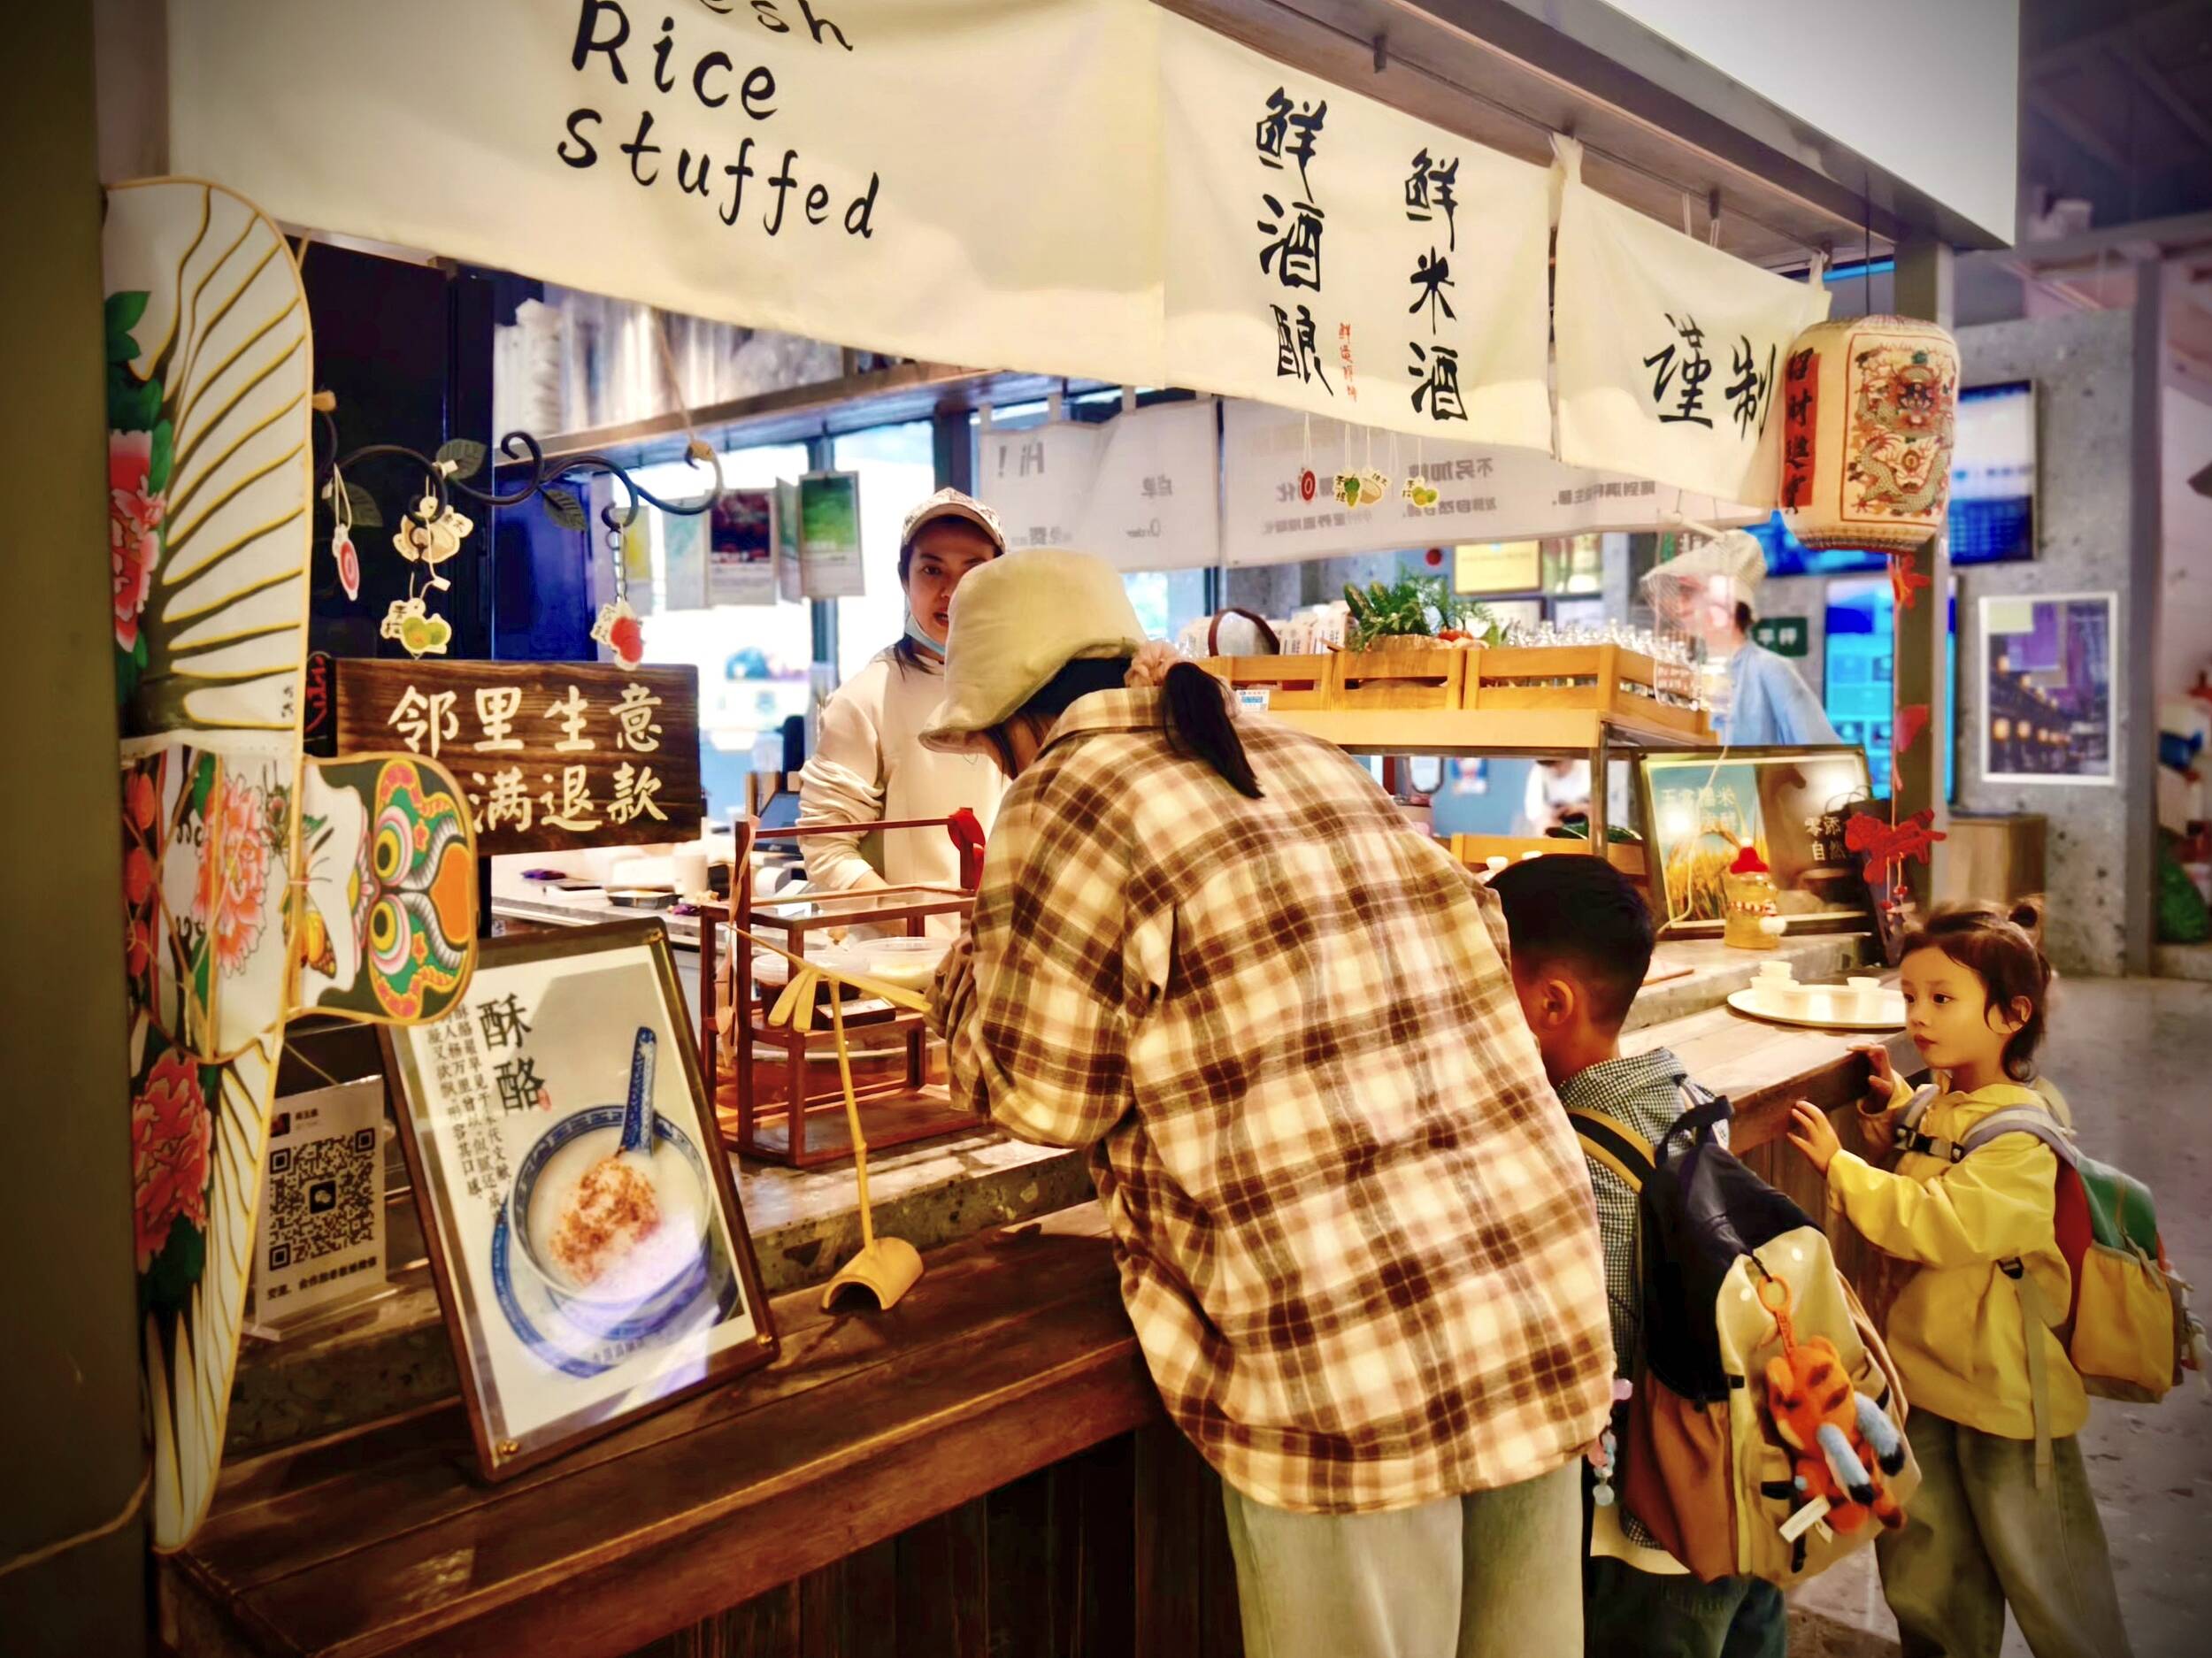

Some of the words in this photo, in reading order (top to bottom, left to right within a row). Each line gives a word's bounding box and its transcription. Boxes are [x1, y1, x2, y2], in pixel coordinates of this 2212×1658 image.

[572, 0, 778, 120] Rice
[1256, 86, 1334, 396] 鲜酒酿
[1404, 147, 1469, 421] 鲜米酒
[387, 682, 663, 758] 邻里生意
[475, 992, 545, 1117] 酥酪
